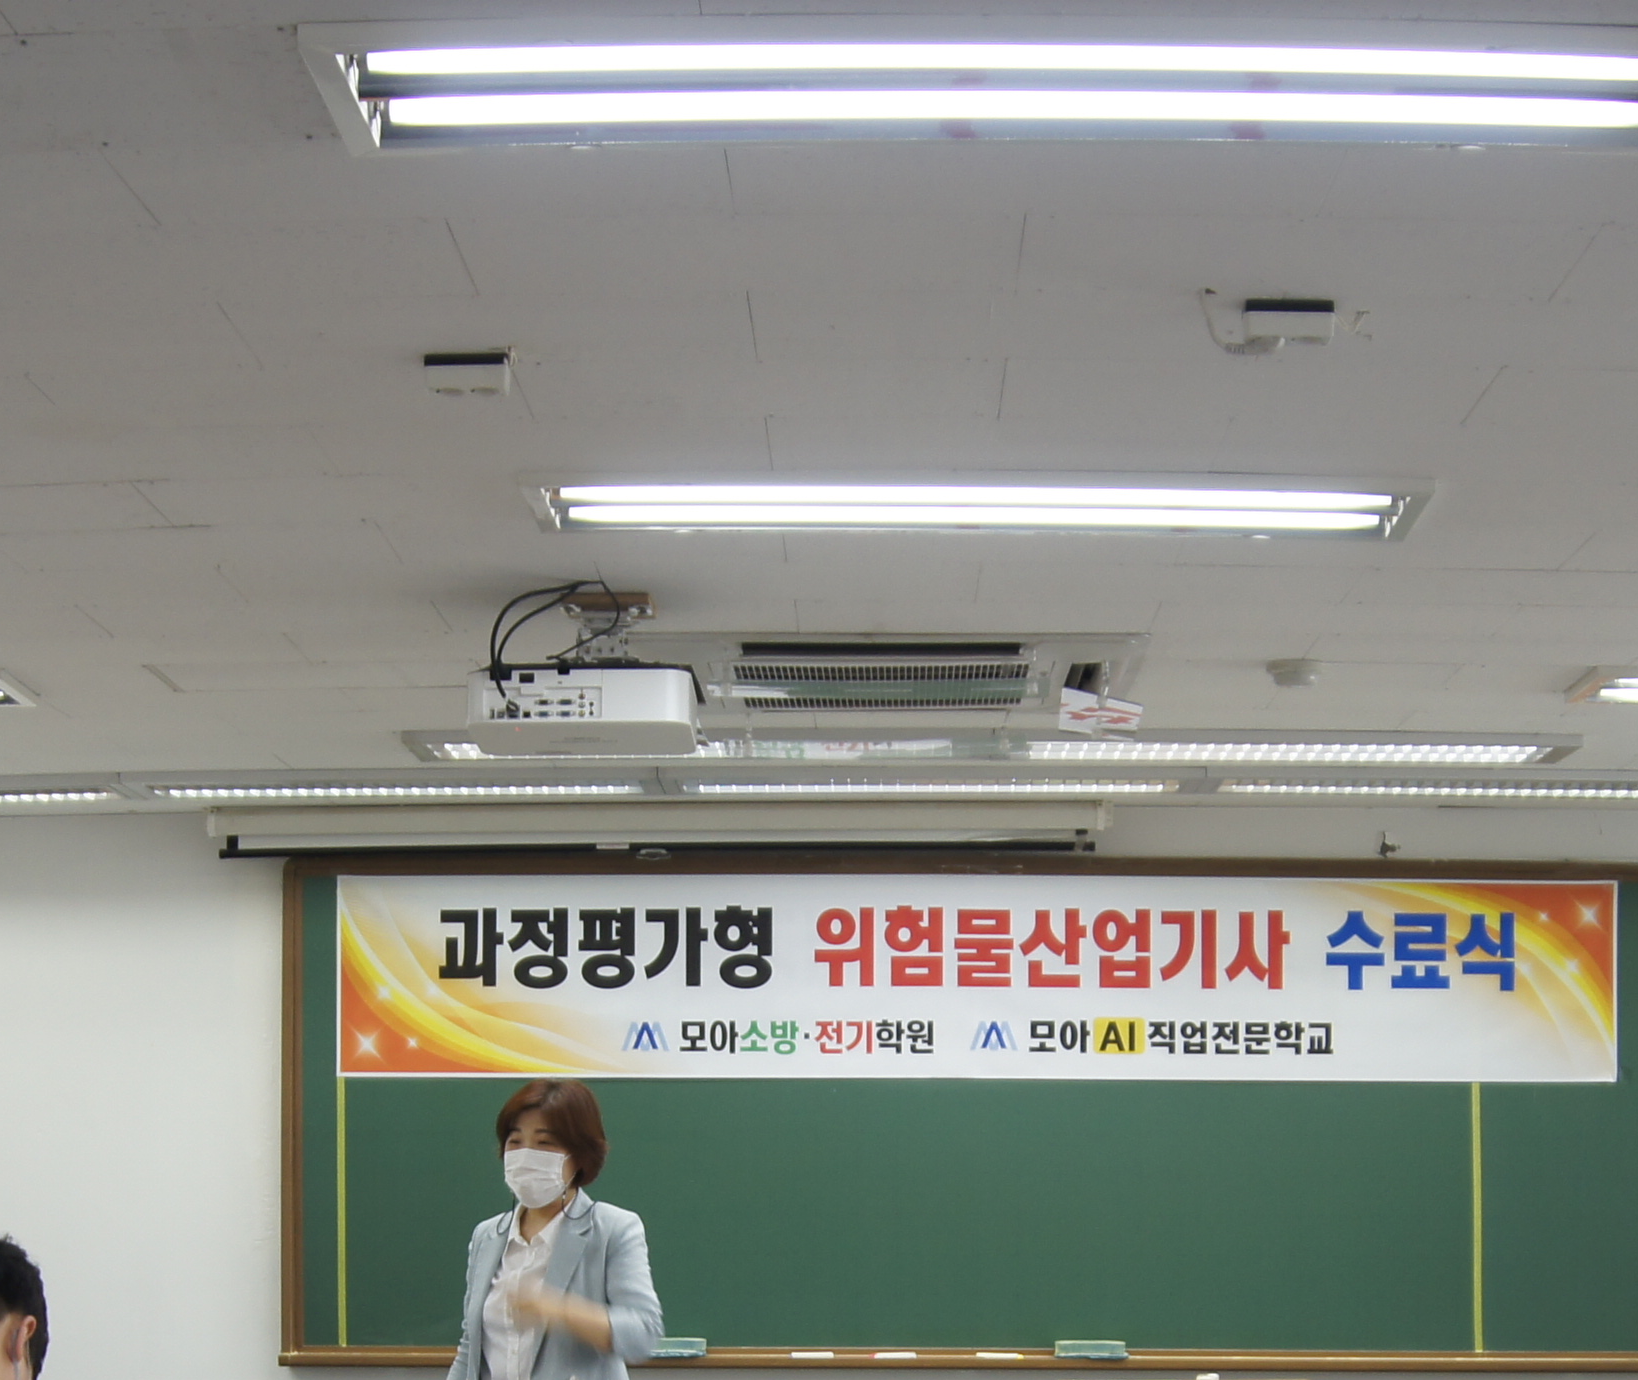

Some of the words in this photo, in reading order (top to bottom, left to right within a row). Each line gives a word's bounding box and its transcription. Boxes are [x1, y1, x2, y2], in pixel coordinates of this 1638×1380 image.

[439, 905, 773, 989] 과정평가형
[814, 905, 1290, 989] 위험물산업기사
[1325, 910, 1516, 992] 수료식
